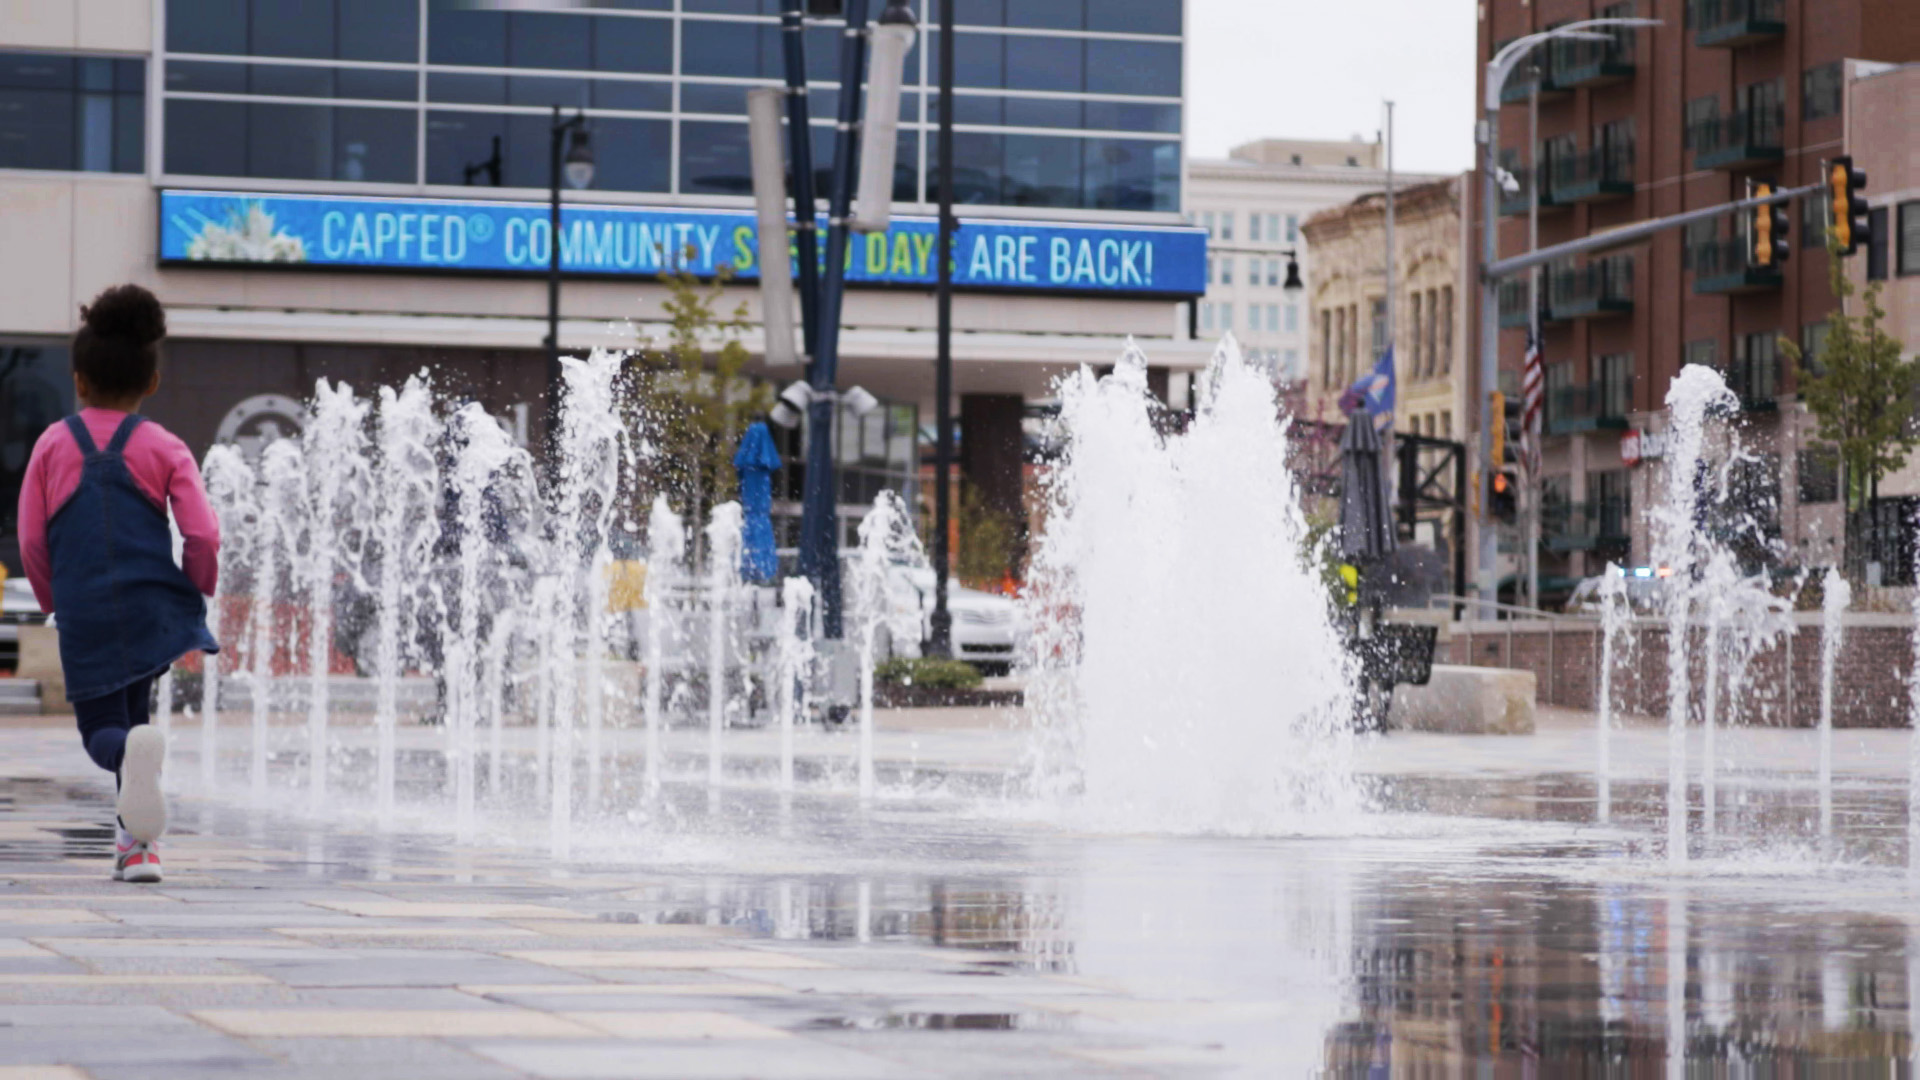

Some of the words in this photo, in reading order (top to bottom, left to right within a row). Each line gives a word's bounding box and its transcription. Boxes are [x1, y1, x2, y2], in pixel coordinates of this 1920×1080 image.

[505, 217, 720, 269] COMMUNITY
[968, 234, 1038, 282] ARE
[1050, 237, 1153, 286] BACK!
